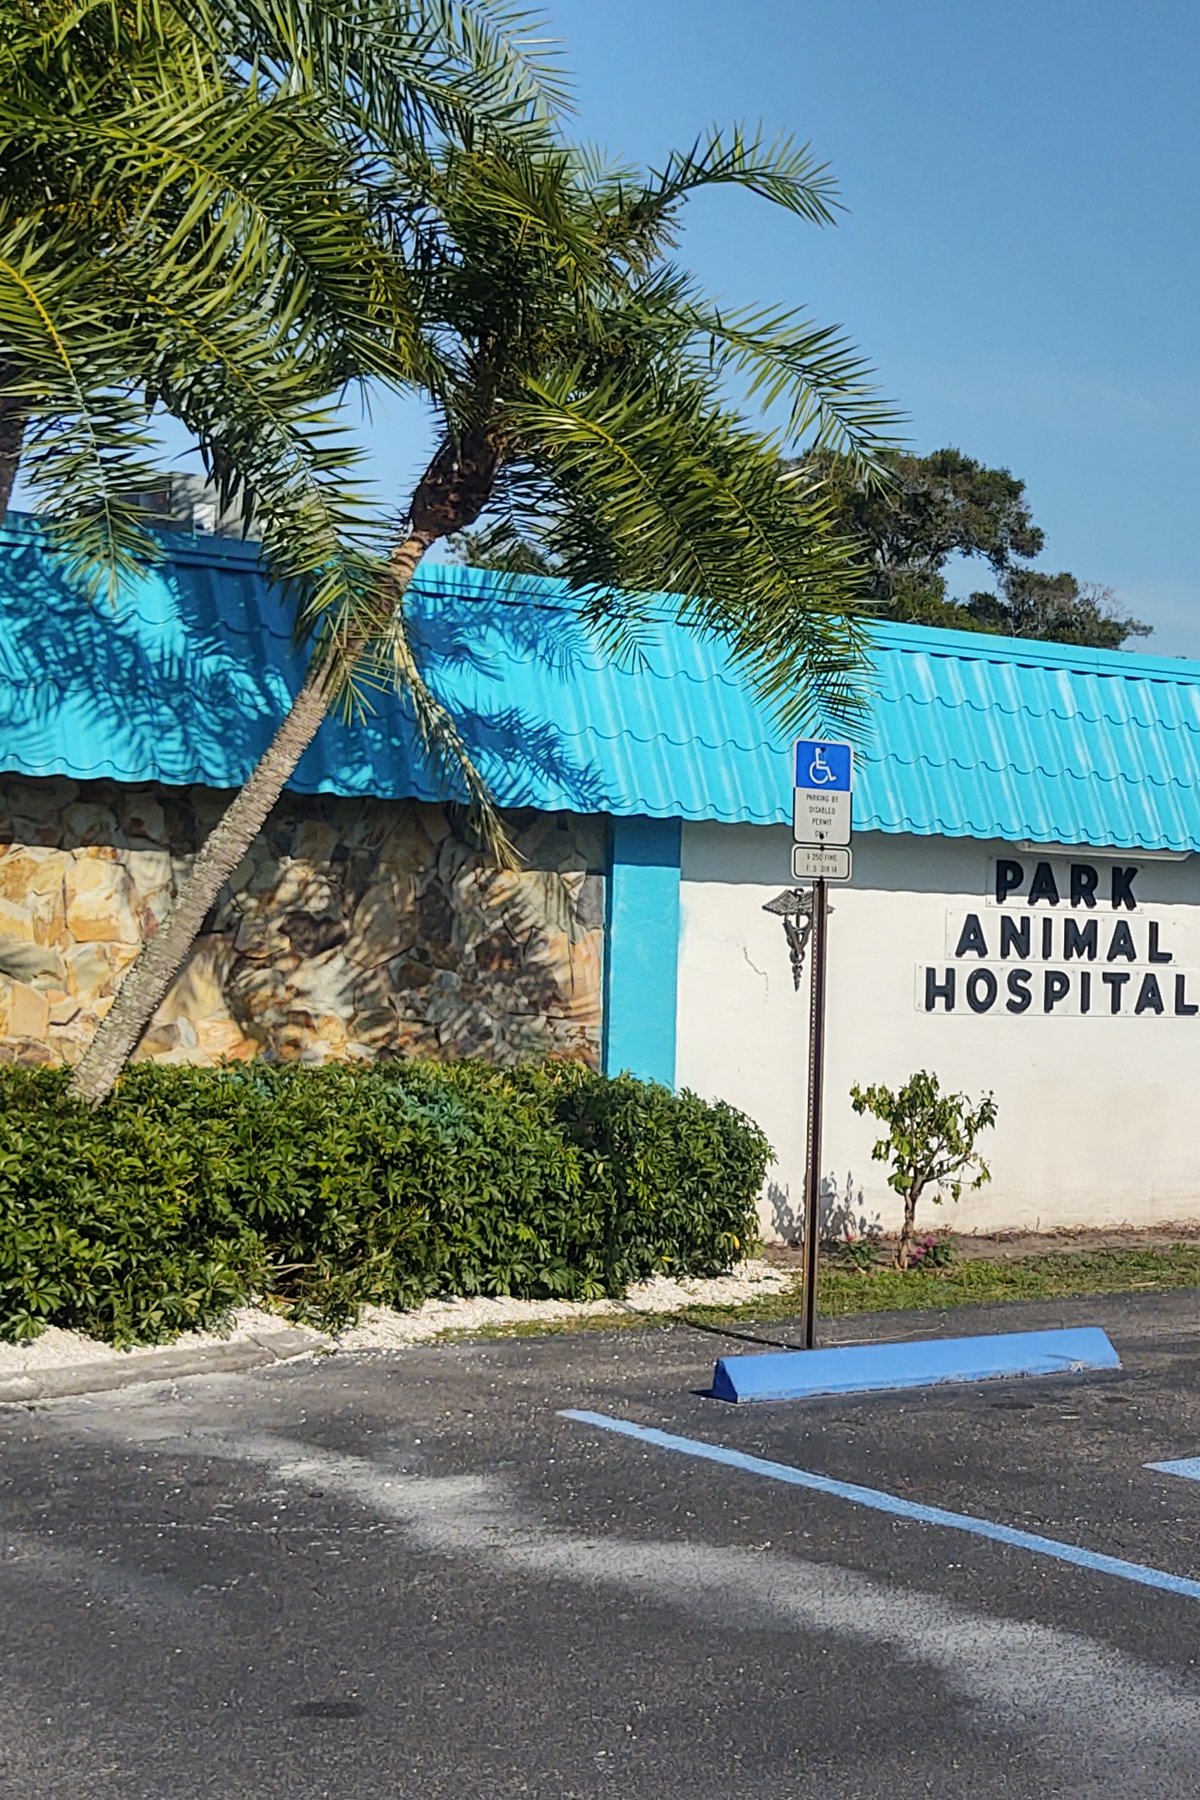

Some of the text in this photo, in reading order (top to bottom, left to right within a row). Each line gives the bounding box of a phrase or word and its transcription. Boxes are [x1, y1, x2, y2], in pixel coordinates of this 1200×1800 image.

[806, 794, 829, 803] PARKING
[808, 806, 836, 815] DISABLED
[811, 818, 832, 826] PERMIT
[995, 859, 1138, 911] PARK
[954, 913, 1174, 964] ANIMAL
[925, 966, 1200, 1016] HOSPITAL
